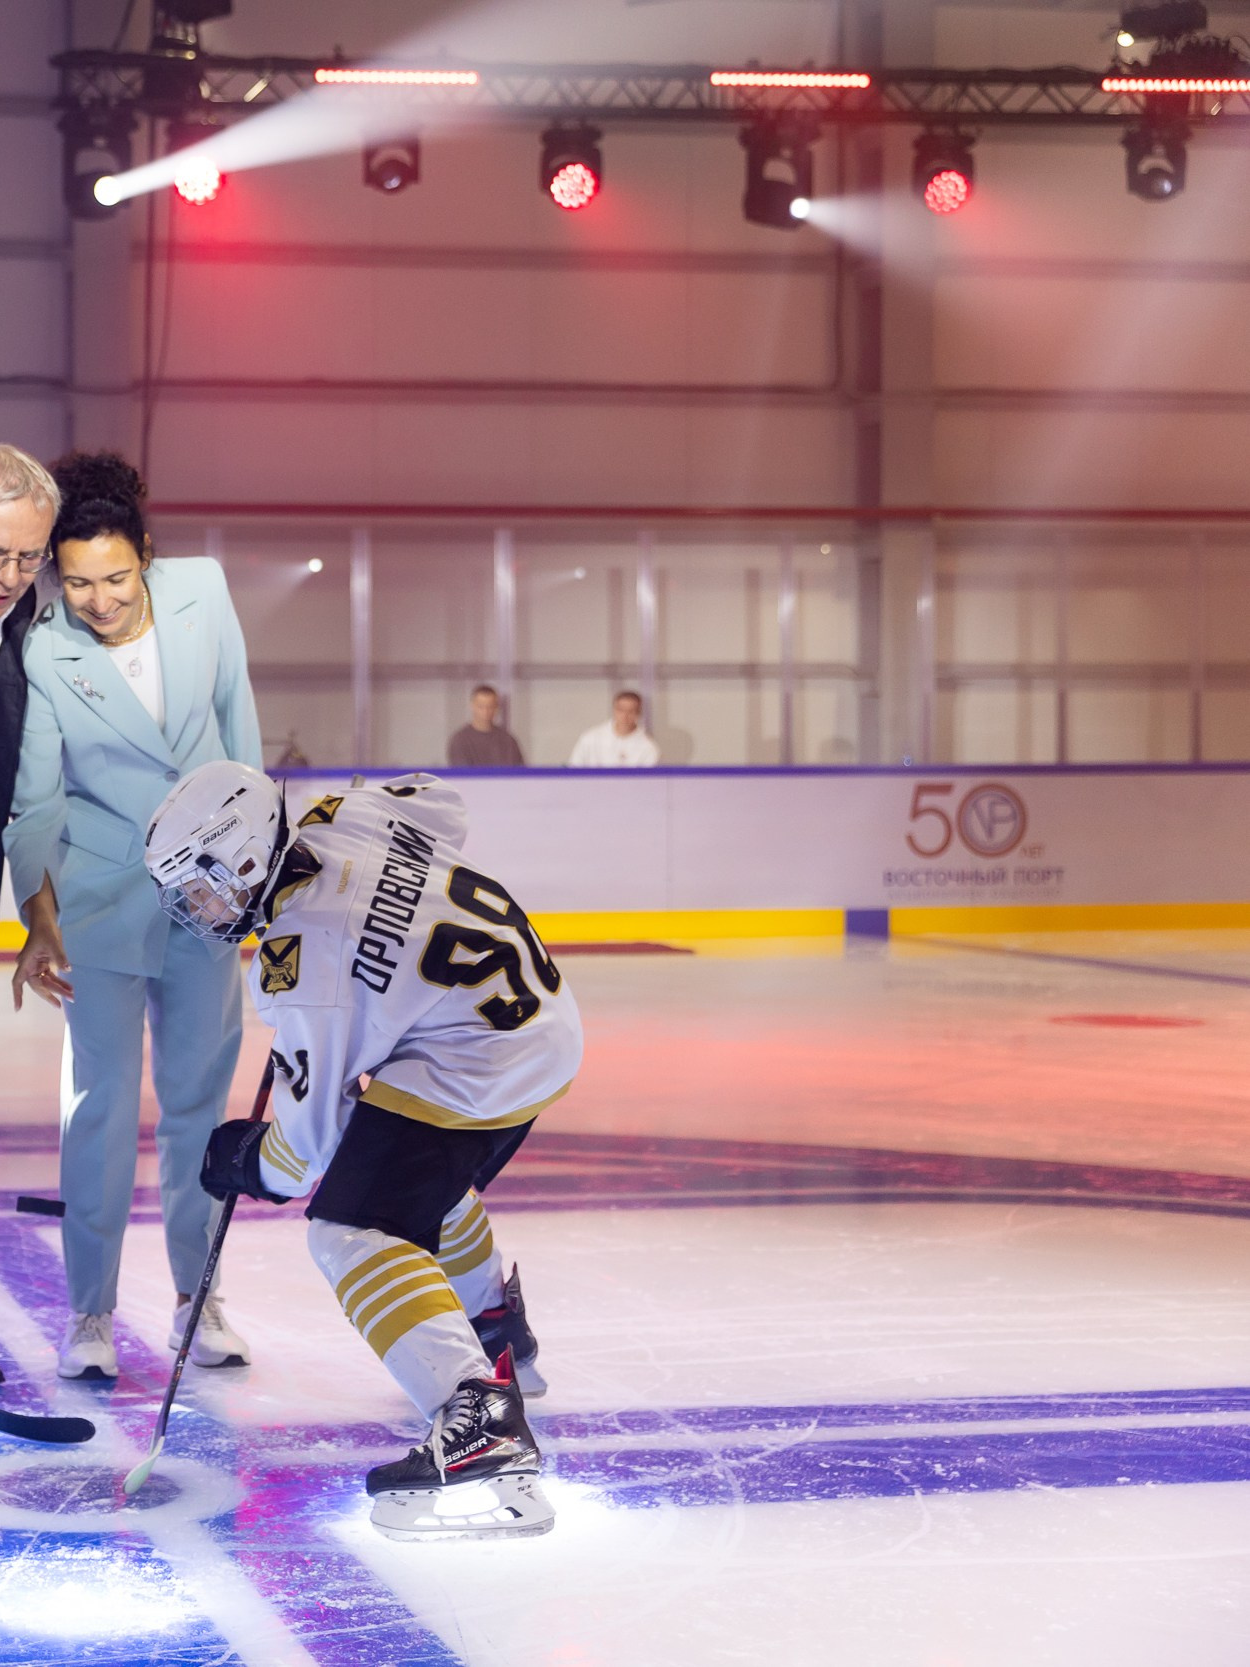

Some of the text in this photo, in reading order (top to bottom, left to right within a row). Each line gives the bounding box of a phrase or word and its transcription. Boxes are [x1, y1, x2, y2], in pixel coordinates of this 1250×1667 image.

[202, 818, 238, 847] BAUER
[906, 782, 1029, 859] 50
[882, 867, 1065, 888] ВОСТОЧНЫЙ ПОРТ
[351, 820, 437, 995] ОРЛОВСКИЙ
[444, 1436, 488, 1466] BAUER
